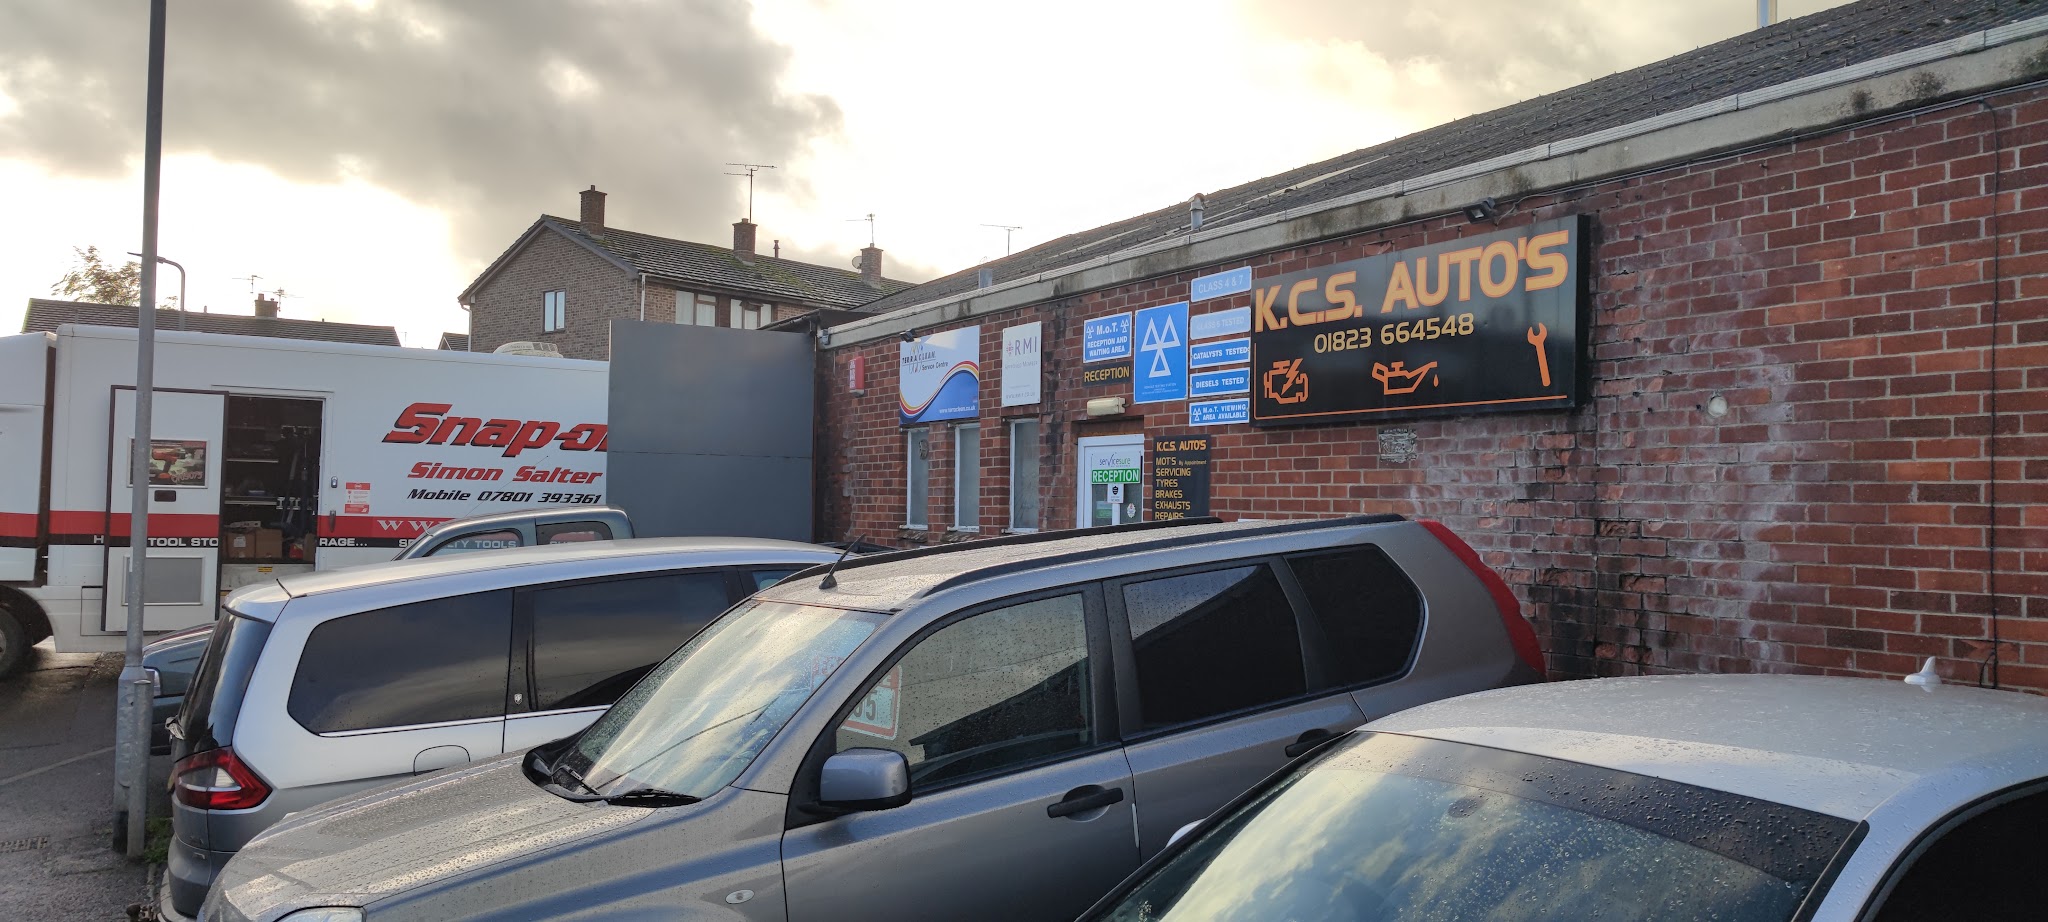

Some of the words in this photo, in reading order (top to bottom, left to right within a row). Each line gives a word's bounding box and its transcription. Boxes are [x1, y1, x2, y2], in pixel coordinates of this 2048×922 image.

[1198, 280, 1223, 294] CLASS
[1225, 277, 1230, 288] 4
[1239, 275, 1244, 285] 7
[1254, 270, 1363, 333] K.C.S.
[1381, 230, 1569, 313] AUTO'S
[1313, 327, 1372, 354] 01823
[1381, 313, 1475, 345] 664548
[1014, 335, 1037, 356] RMI
[1087, 338, 1116, 348] RECEPTION
[1116, 335, 1128, 344] AND
[1088, 347, 1110, 357] WAITING
[1111, 345, 1125, 354] AREA
[1193, 349, 1223, 360] CATALYSTS
[1225, 346, 1248, 356] TESTED
[1084, 366, 1130, 383] RECEPTION
[1195, 380, 1219, 389] DIESELS
[1222, 377, 1245, 386] TESTED
[1221, 404, 1246, 412] VIEWING
[1202, 413, 1216, 421] AREA
[1218, 411, 1246, 420] AVAILABLE
[381, 402, 608, 457] Snap-o
[1156, 441, 1176, 452] K.C.S.
[1179, 439, 1207, 451] AUTO'S
[1155, 456, 1177, 466] MOT'S
[407, 461, 504, 481] Simon
[512, 465, 604, 484] Salter
[1092, 469, 1139, 483] RECEPTION
[1155, 467, 1191, 477] SERVICING
[1155, 478, 1178, 488] TYRES
[407, 488, 471, 501] Mobile
[477, 490, 534, 503] 07801
[537, 492, 602, 505] 393361
[1155, 489, 1183, 499] BRAKES
[1155, 500, 1191, 510] EXHAUSTS
[1154, 511, 1184, 520] REPAIRS
[147, 537, 187, 547] TOOL
[474, 540, 517, 549] TOOLS
